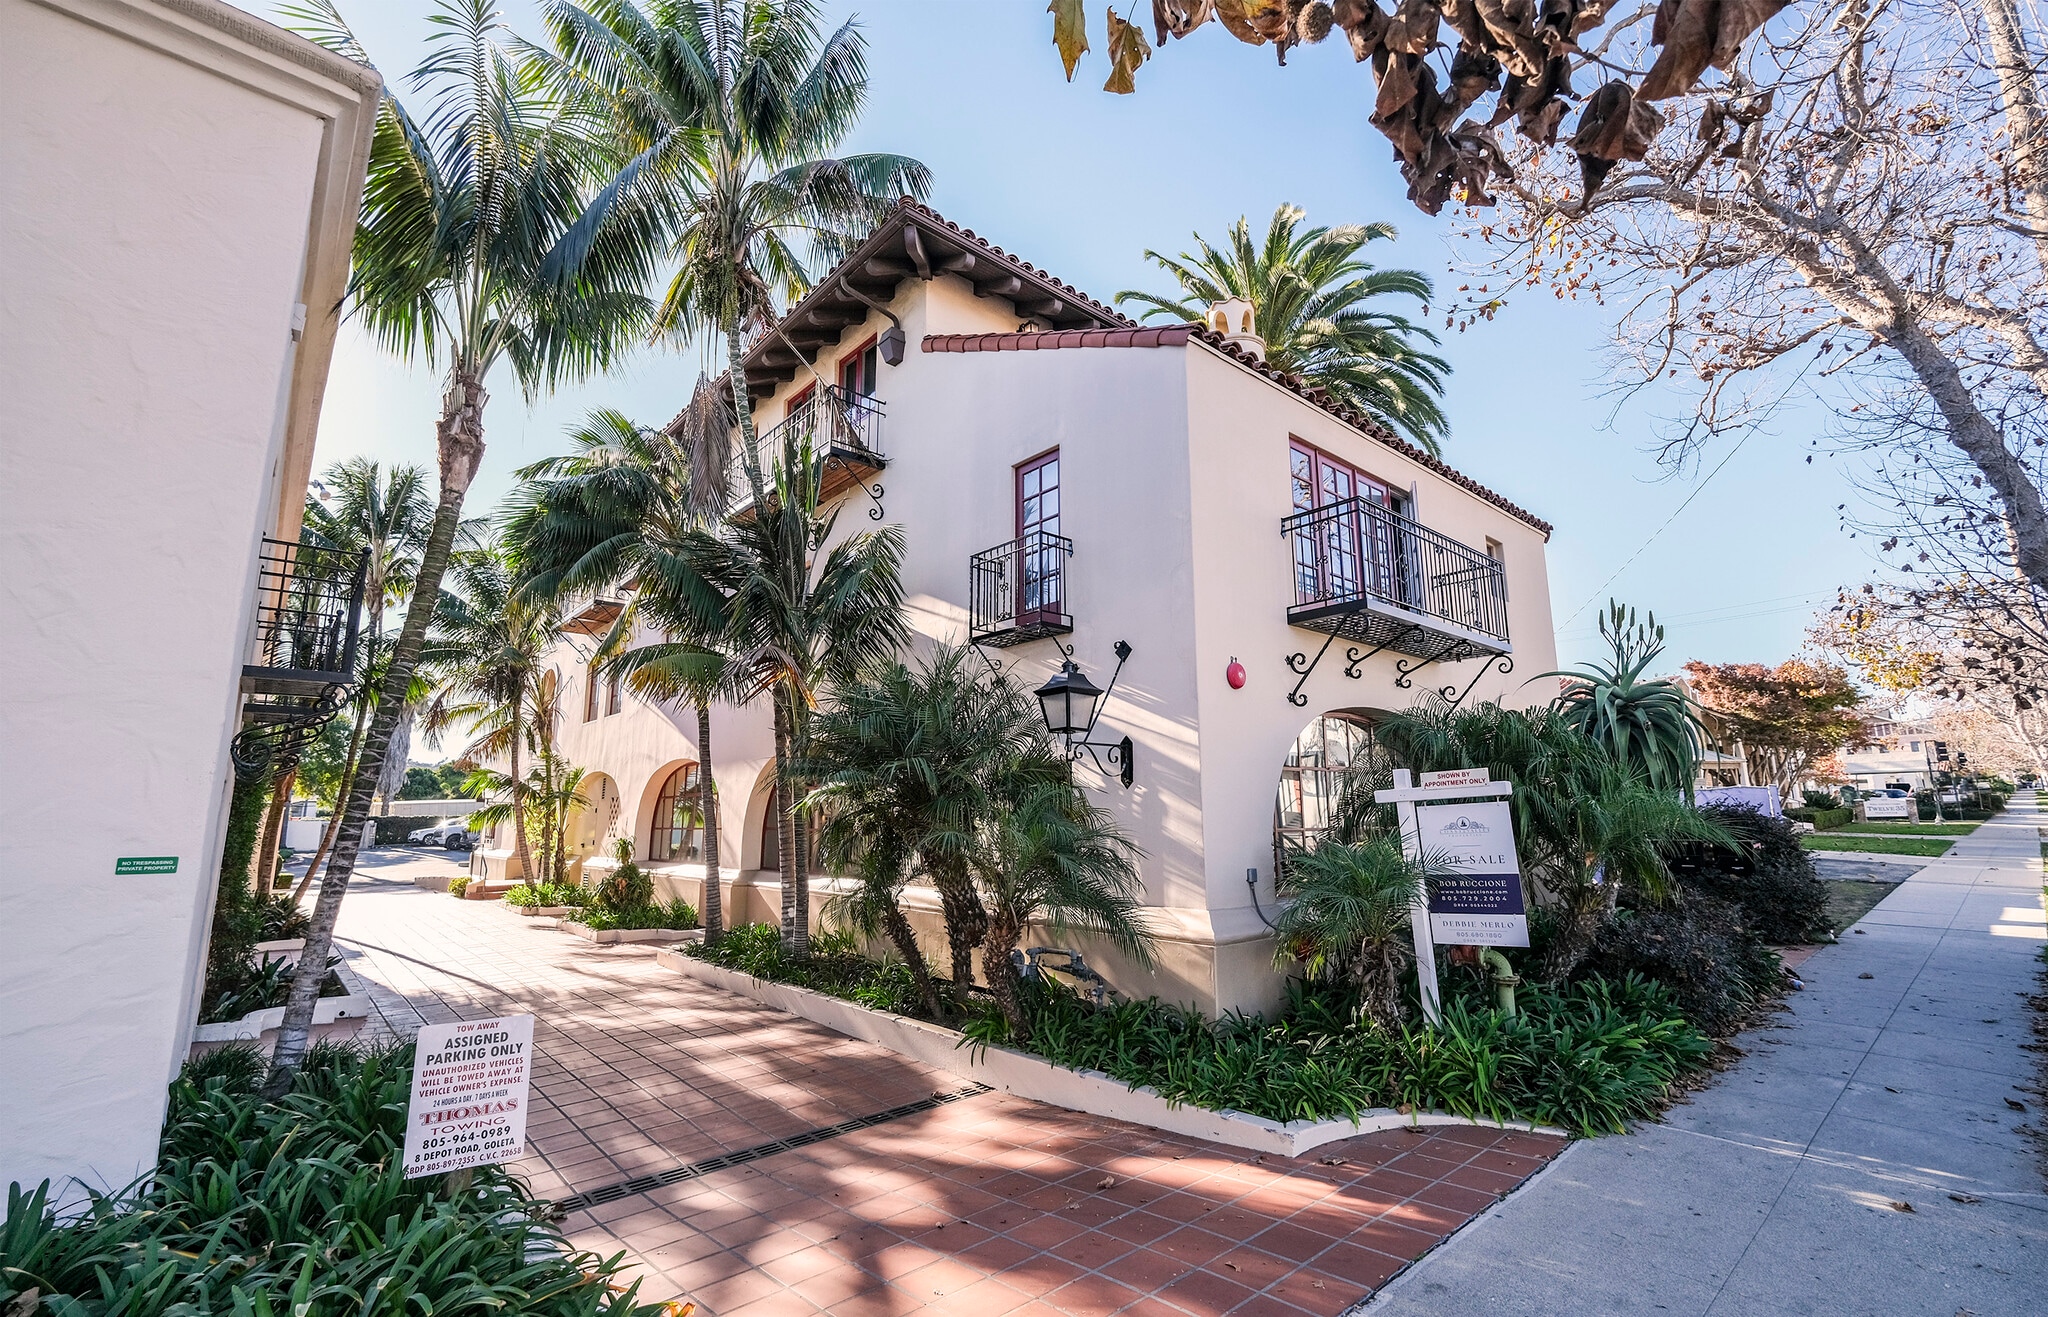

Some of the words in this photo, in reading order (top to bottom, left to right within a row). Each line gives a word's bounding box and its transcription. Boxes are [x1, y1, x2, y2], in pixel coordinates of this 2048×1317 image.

[1424, 779, 1468, 787] APPOINTMENT
[1469, 855, 1506, 864] SALE
[457, 1024, 475, 1033] TOW
[477, 1021, 500, 1030] AWAY
[445, 1032, 509, 1049] ASSIGNED
[426, 1048, 486, 1065] PARKING
[491, 1043, 523, 1057] ONLY
[421, 1078, 440, 1087] WILL
[444, 1076, 453, 1084] BE
[457, 1072, 485, 1082] TOWED
[487, 1068, 511, 1078] AWAY
[422, 1062, 486, 1078] UNAUTHORIZED
[489, 1057, 524, 1068] VEHICLES
[419, 1087, 450, 1098] VEHICLE
[453, 1081, 487, 1093] OWNER'S
[490, 1076, 524, 1087] EXPENSE.
[441, 1097, 458, 1106] HOURS
[475, 1093, 479, 1101] 7
[479, 1092, 491, 1100] DAYS
[495, 1089, 508, 1097] WEEK
[419, 1097, 519, 1126] THOMAS
[431, 1117, 506, 1135] TOWING
[422, 1125, 511, 1150] 805-964-0989
[414, 1154, 421, 1163] 8
[424, 1148, 453, 1161] DEPOT
[455, 1144, 481, 1155] ROAD,
[484, 1137, 515, 1150] GOLETA
[427, 1155, 475, 1172] 805-897-2355
[479, 1153, 499, 1161] C.V.C.
[500, 1147, 522, 1157] 22658
